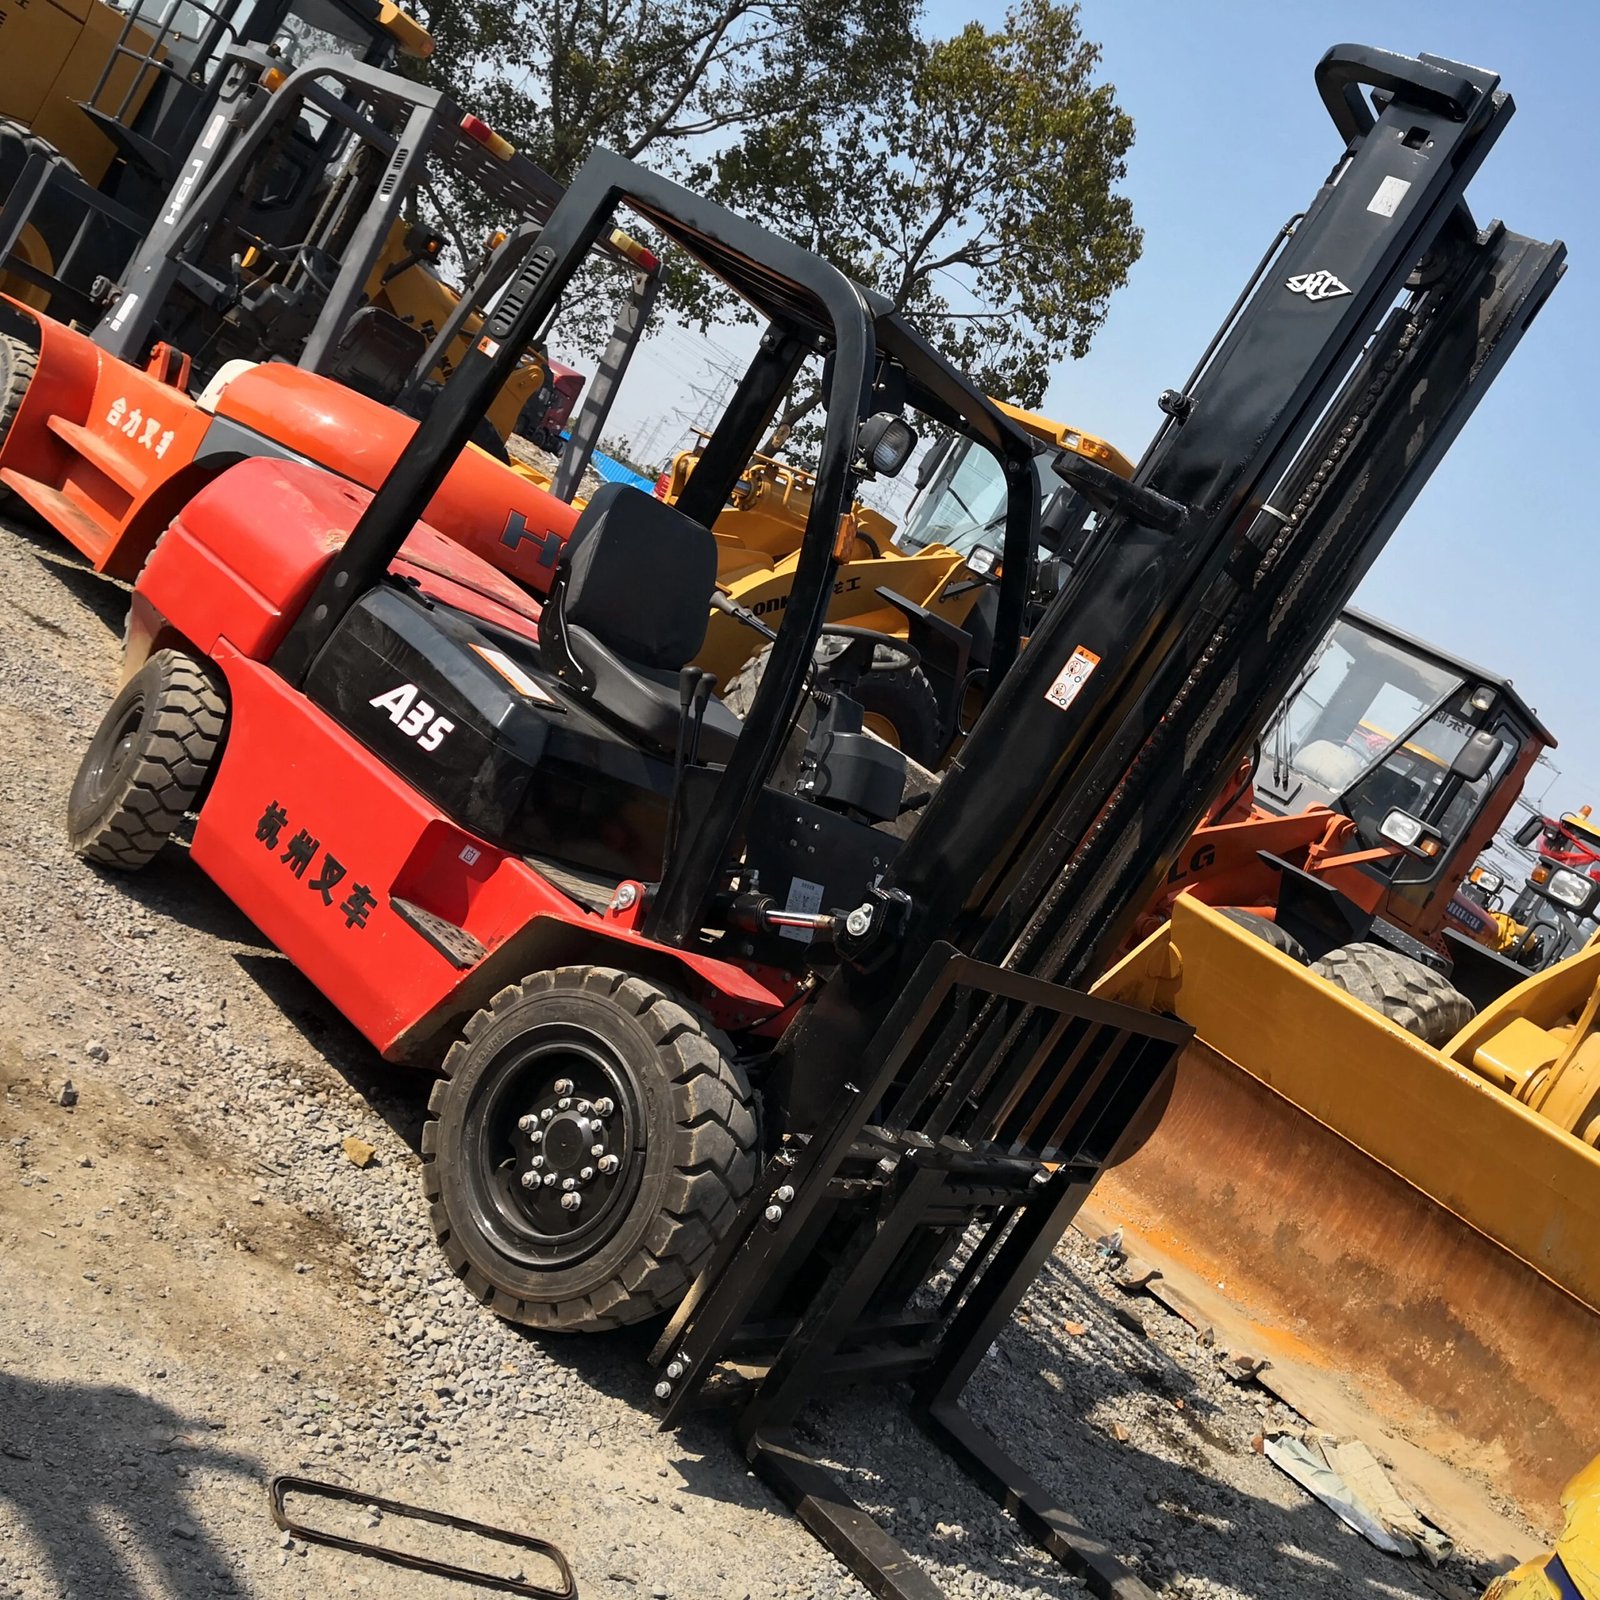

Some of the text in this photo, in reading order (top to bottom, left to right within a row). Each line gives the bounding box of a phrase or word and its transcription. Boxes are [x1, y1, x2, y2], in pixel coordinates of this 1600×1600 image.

[105, 396, 175, 460] 合力叉车
[368, 683, 455, 752] A35
[255, 799, 378, 930] 杭州叉车
